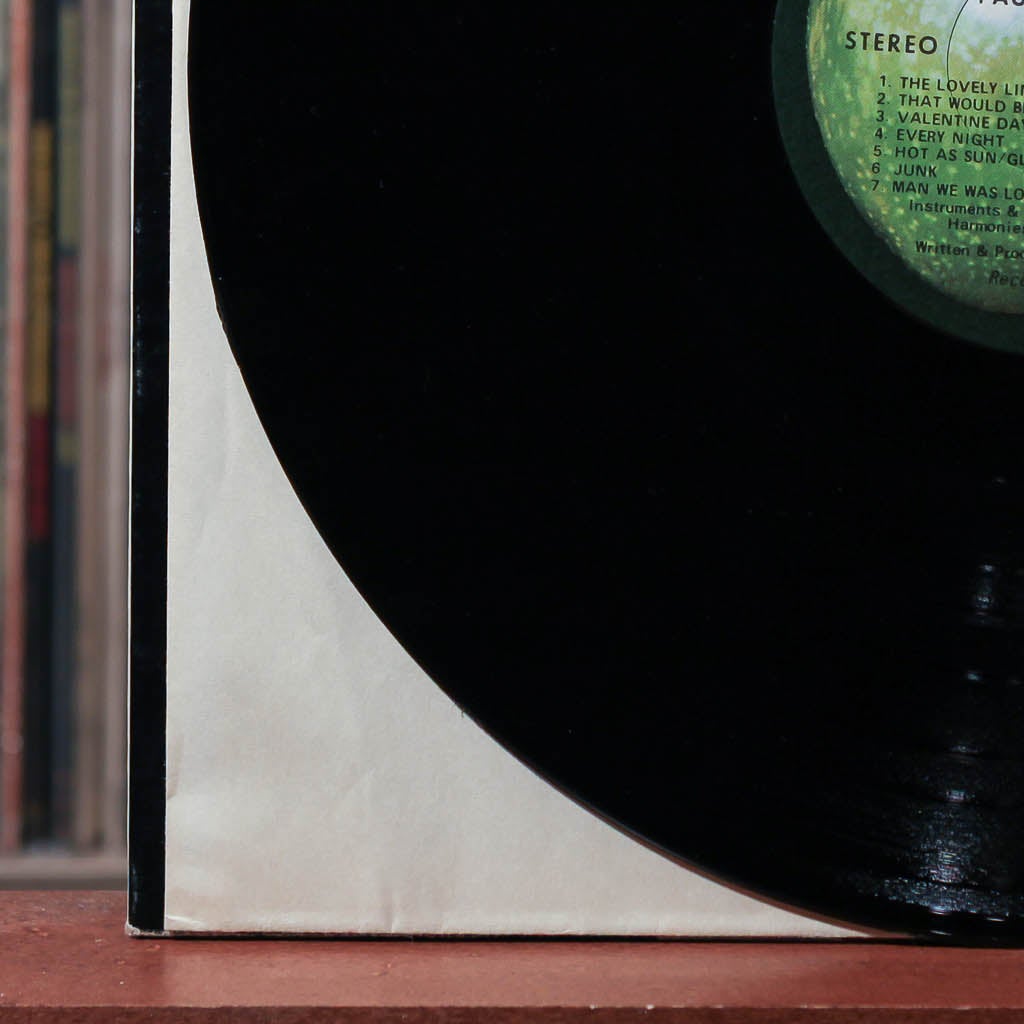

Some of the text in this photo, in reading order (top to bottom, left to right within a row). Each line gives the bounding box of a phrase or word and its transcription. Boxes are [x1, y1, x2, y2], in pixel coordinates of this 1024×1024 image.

[845, 31, 938, 55] STEREO
[879, 75, 892, 88] 1.
[900, 76, 930, 91] THE
[937, 78, 998, 95] LOVELY
[899, 94, 942, 108] THAT
[949, 97, 1006, 113] WOULD
[898, 111, 990, 129] VALENTINE
[896, 128, 945, 144] EVERY
[952, 132, 1004, 147] NIGHT
[895, 146, 928, 160] HOT
[936, 148, 958, 162] AS
[894, 164, 937, 178] JUNK
[892, 180, 929, 195] MAN
[937, 183, 959, 197] WE
[964, 184, 998, 200] WAS
[909, 199, 1001, 217] Instruments
[1007, 205, 1019, 218] &
[915, 240, 970, 257] Written
[976, 244, 988, 257] &
